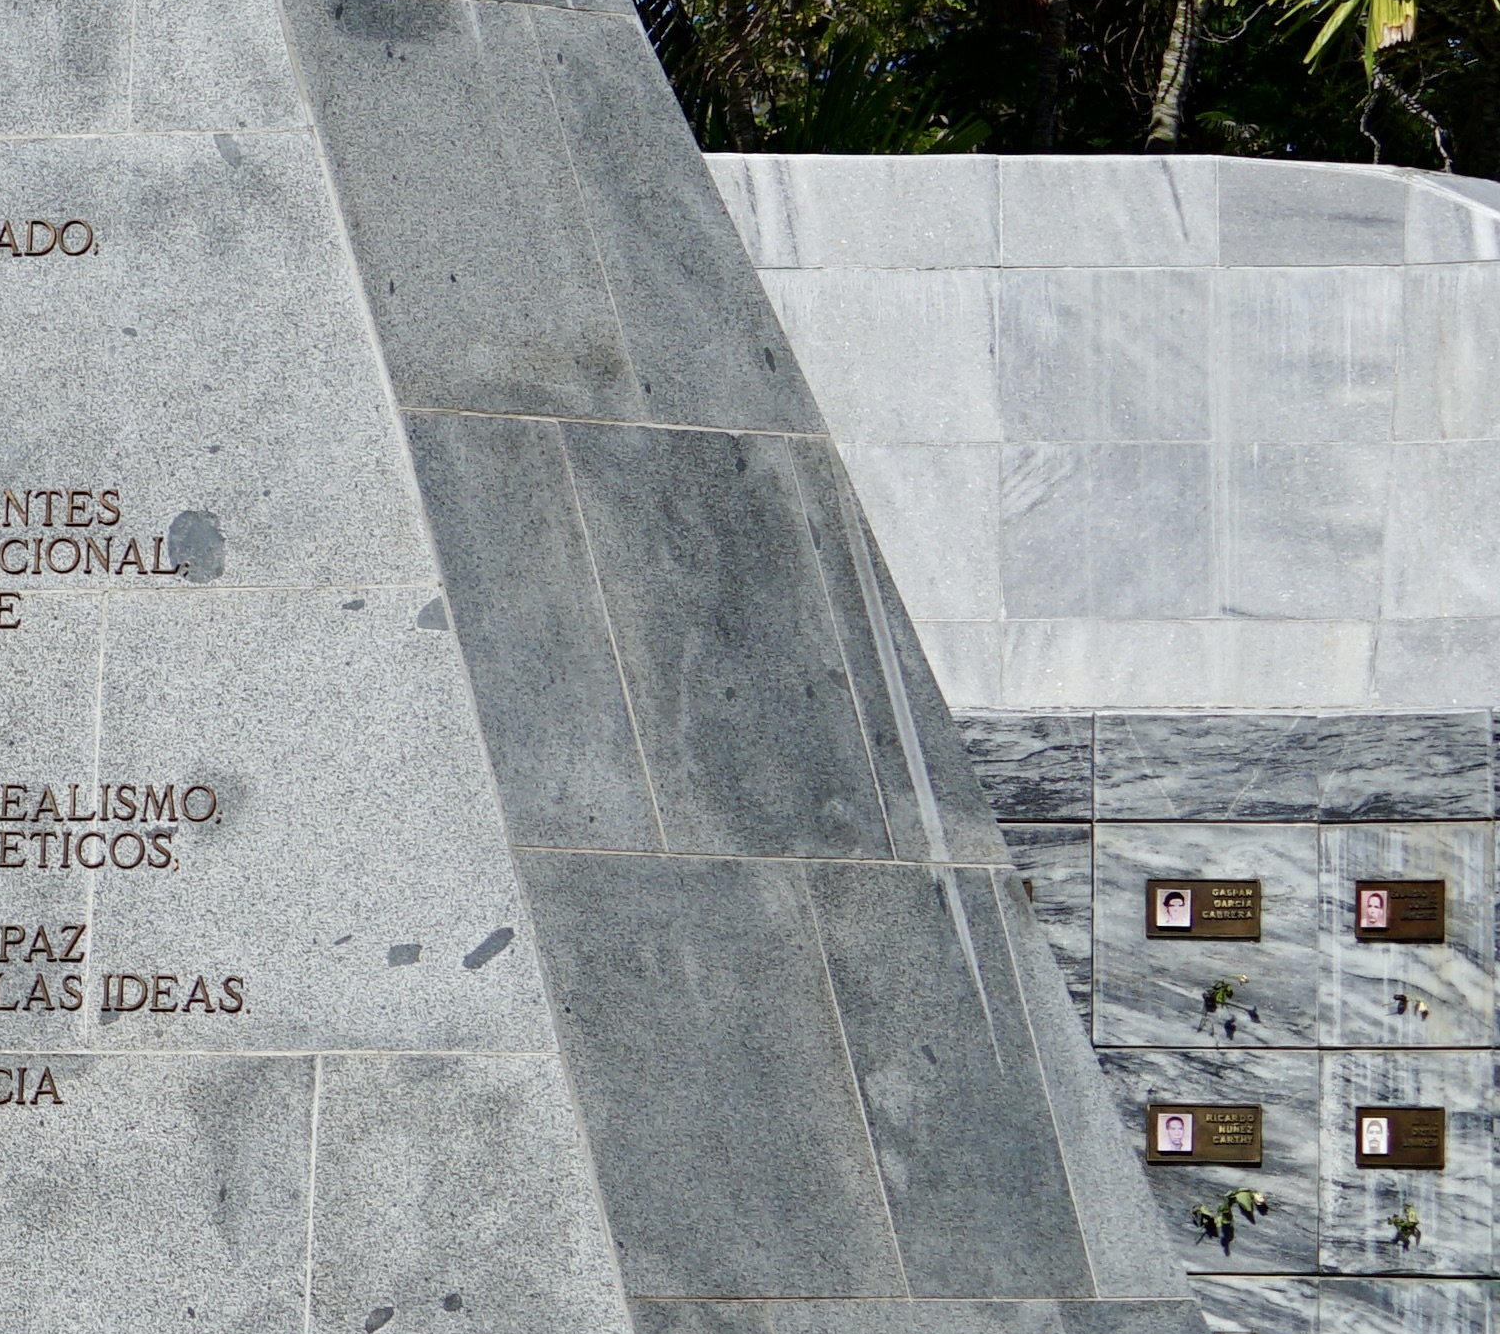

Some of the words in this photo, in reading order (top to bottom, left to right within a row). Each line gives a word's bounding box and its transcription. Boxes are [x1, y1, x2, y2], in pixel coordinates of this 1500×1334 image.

[1211, 889, 1253, 897] GASPAR
[1213, 900, 1253, 908] GARCIA
[1202, 910, 1253, 919] CABRERA
[102, 972, 250, 1015] IDEAS.
[1206, 1113, 1255, 1123] RICARDO
